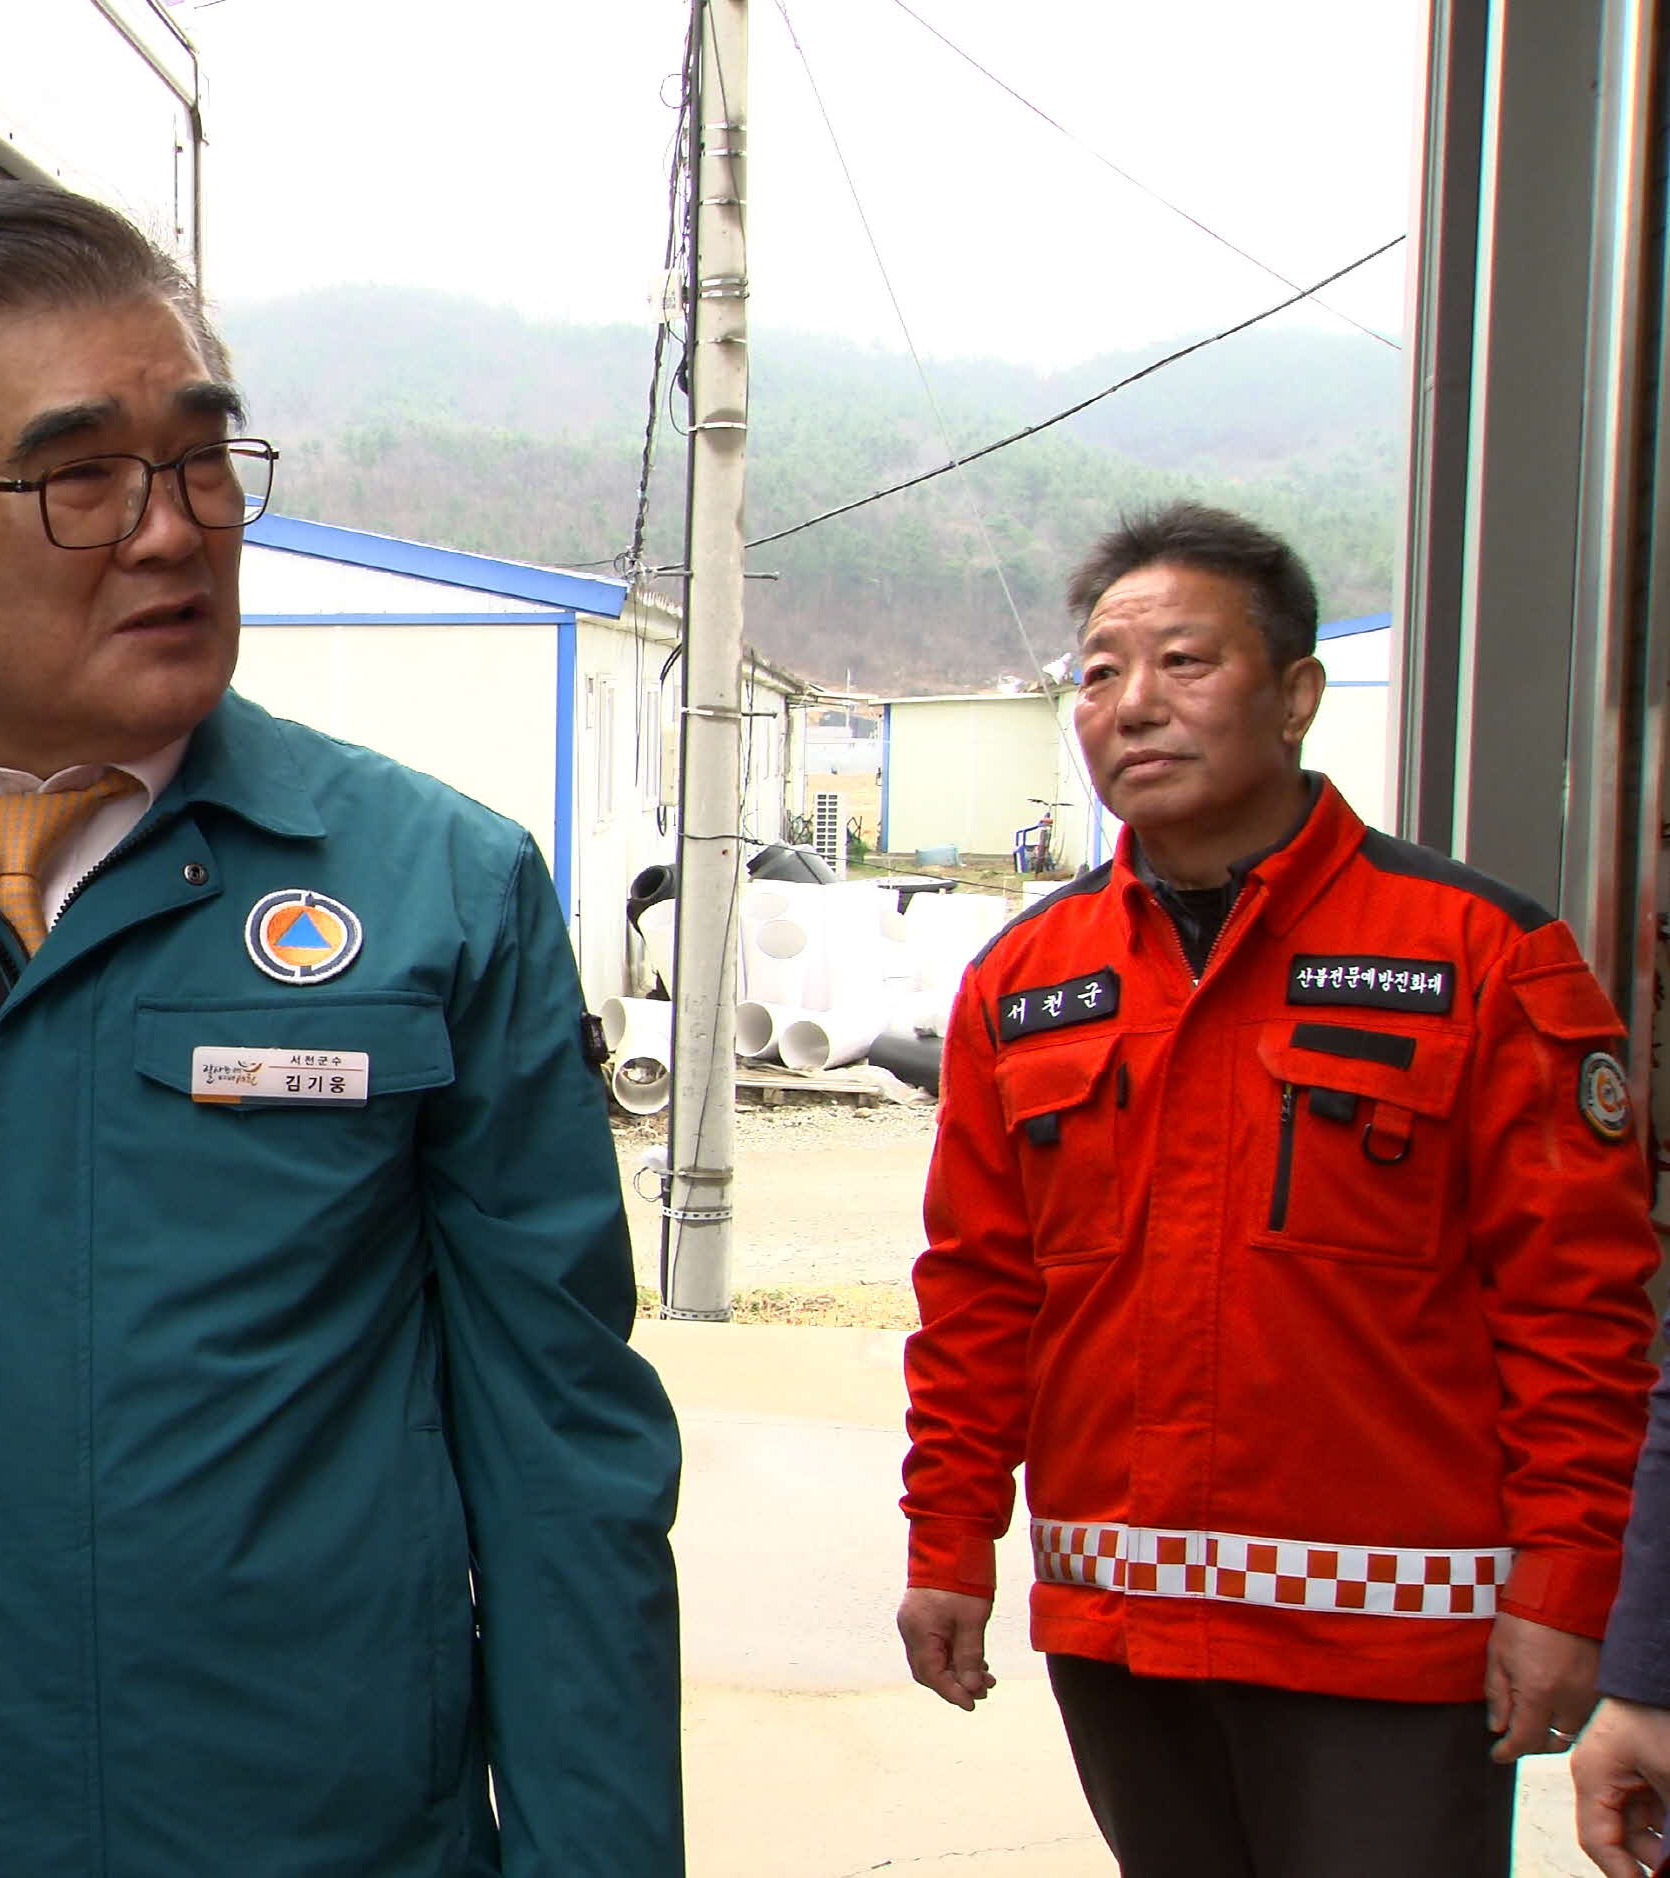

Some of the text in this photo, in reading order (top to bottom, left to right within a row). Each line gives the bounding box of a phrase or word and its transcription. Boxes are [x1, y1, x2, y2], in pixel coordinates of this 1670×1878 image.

[1296, 966, 1443, 996] 산불전문예방진화대
[1007, 981, 1103, 1025] 서천군
[290, 1055, 342, 1067] 서천군수
[285, 1074, 346, 1094] 김기웅
